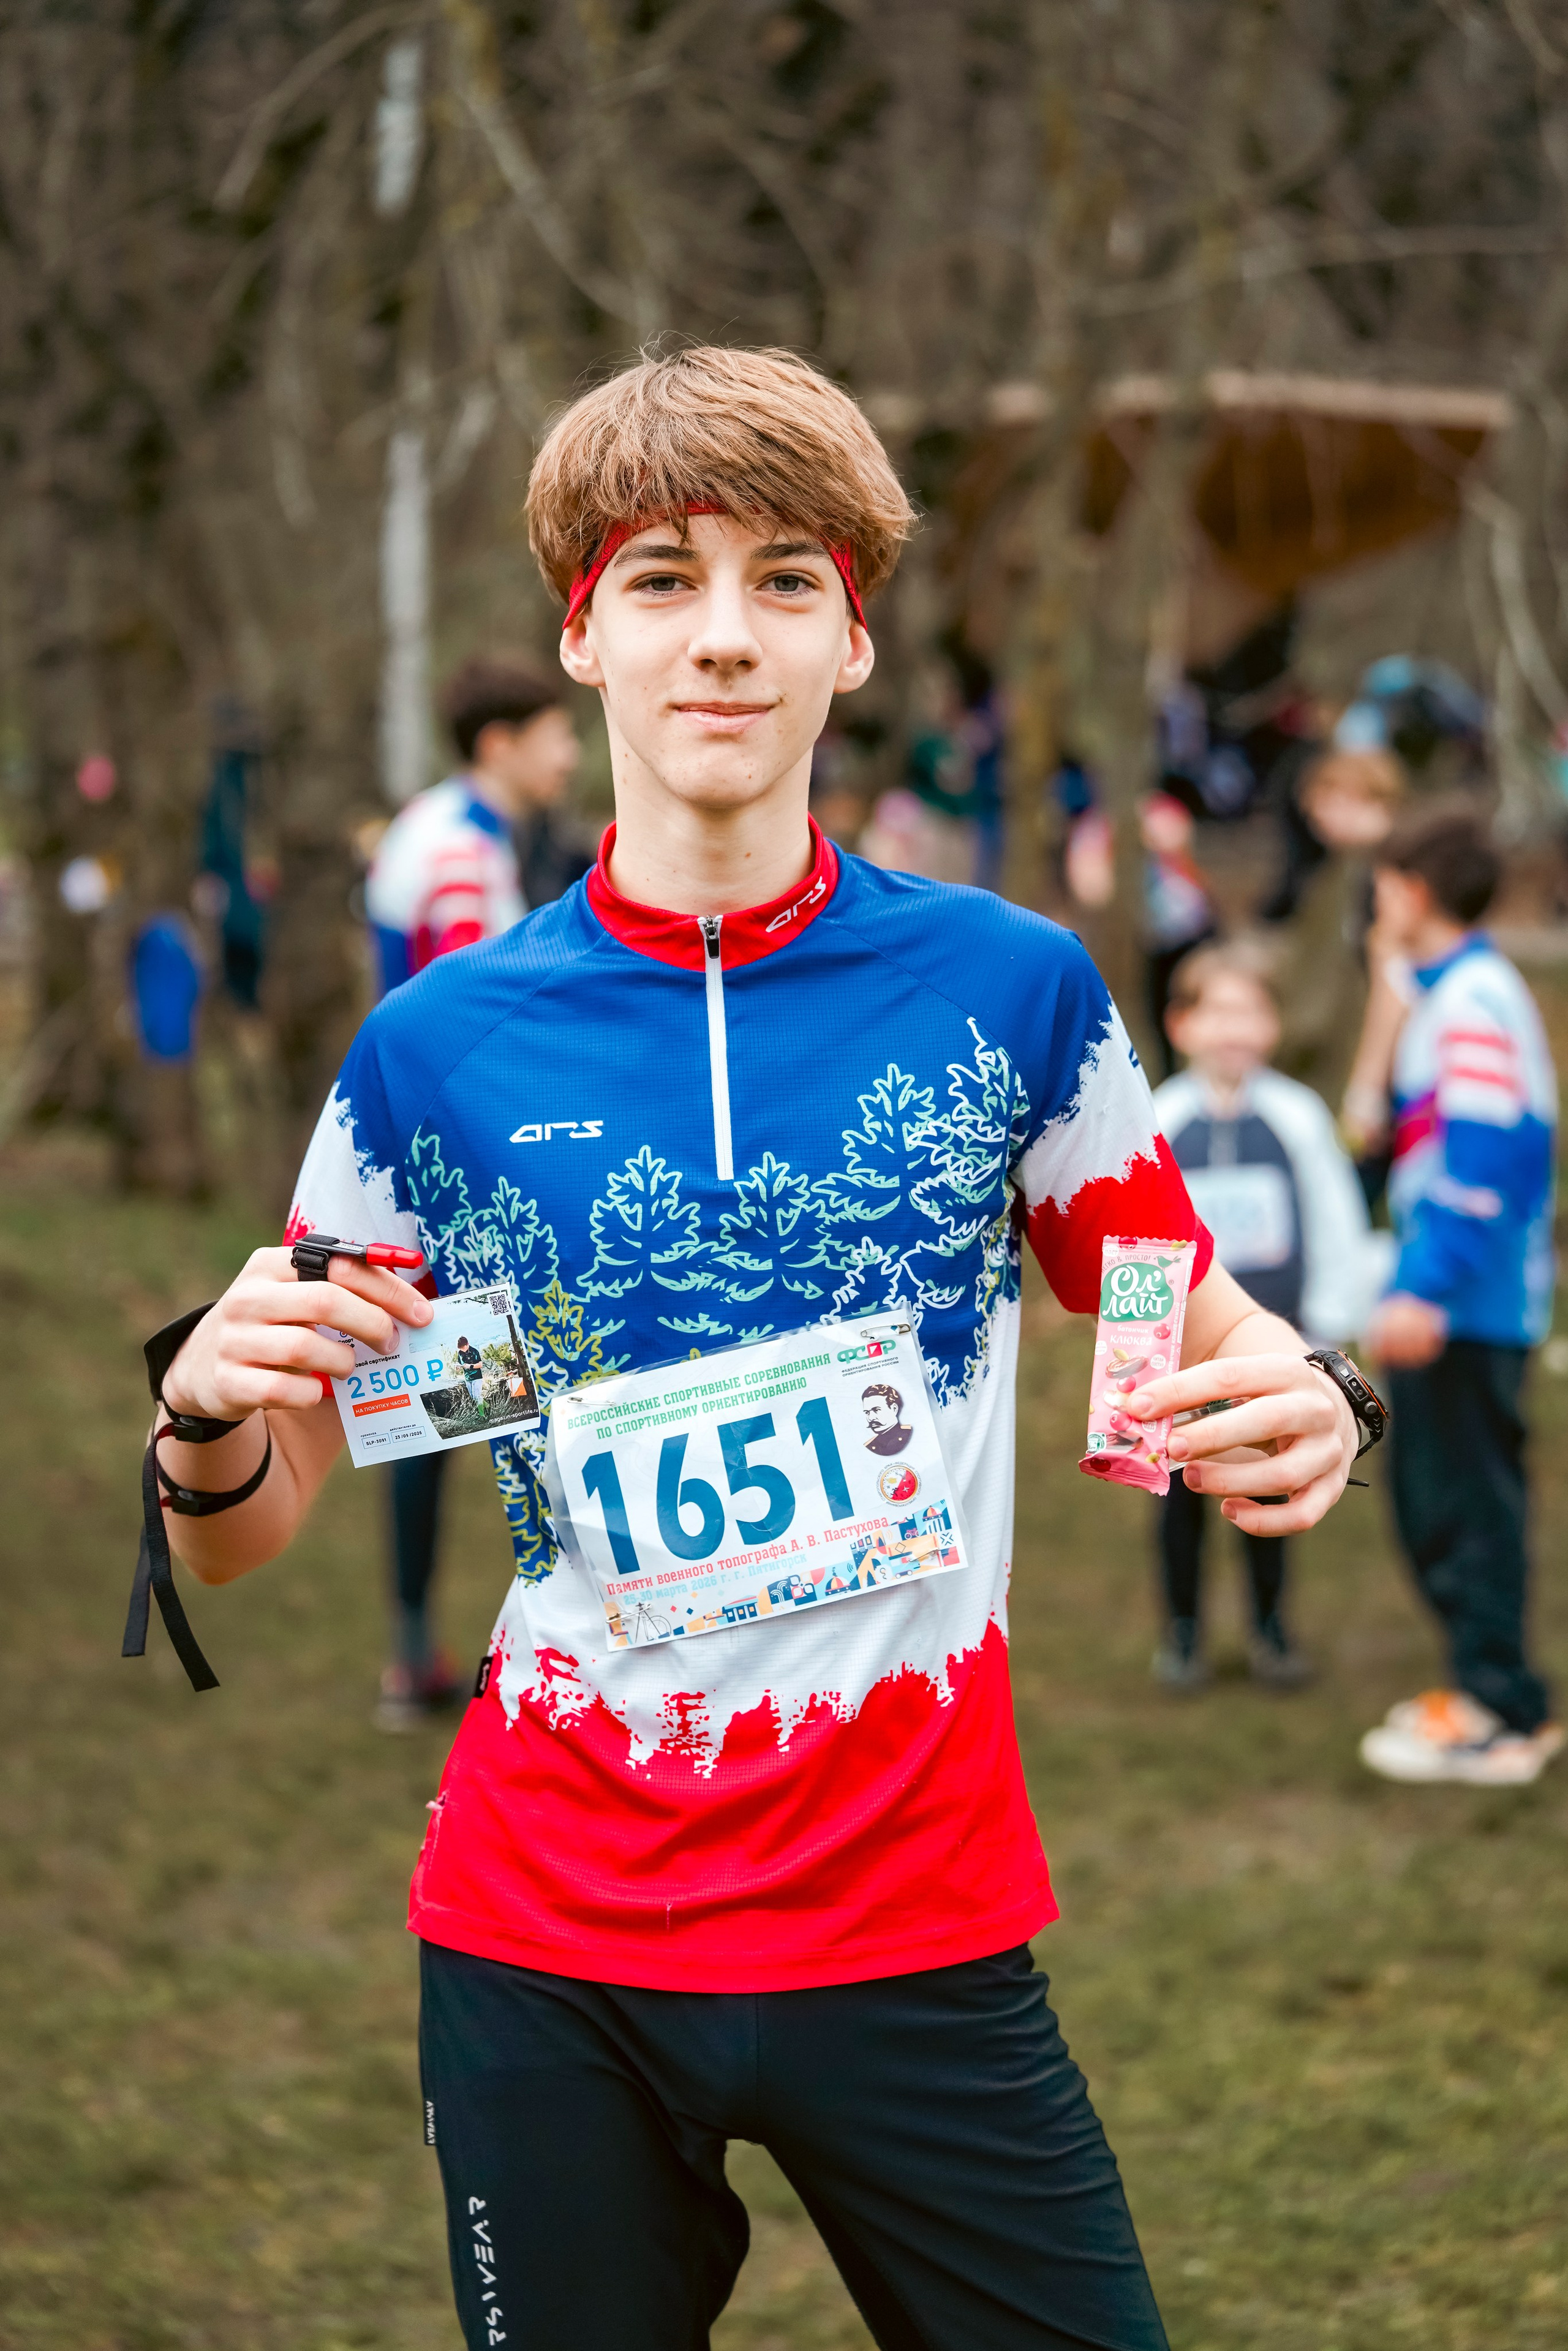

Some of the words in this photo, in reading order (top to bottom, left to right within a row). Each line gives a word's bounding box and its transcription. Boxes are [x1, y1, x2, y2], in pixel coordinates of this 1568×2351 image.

[1117, 1324, 1149, 1334] батончик
[369, 1354, 401, 1365] сертификат
[841, 1364, 867, 1373] ФЕДЕРАЦИЯ
[867, 1356, 899, 1367] СПОРТИВНОГО
[842, 1365, 881, 1377] ОРИЕНТИРОВАНИЯ
[567, 1396, 661, 1430] ВСЕРОССИЙСКИЕ
[663, 1376, 741, 1405] СПОРТИВНЫЕ
[744, 1353, 831, 1386] СОРЕВНОВАНИЯ
[364, 1403, 390, 1412] ПОКУПКУ
[489, 1408, 538, 1424] magazin-sportlife.ru
[596, 1426, 612, 1440] ПО
[615, 1404, 698, 1435] СПОРТИВНОМУ
[701, 1376, 808, 1414] ОРИЕНТИРОВАНИЮ
[581, 1397, 854, 1575] 1651
[606, 1576, 654, 1596] Памяти
[656, 1563, 714, 1585] военного
[717, 1544, 787, 1570] топографа
[790, 1539, 803, 1552] А.
[806, 1534, 821, 1547] В.
[823, 1517, 889, 1542] Пастухова
[623, 1590, 653, 1606] 25-30
[655, 1583, 688, 1599] марта
[690, 1575, 717, 1591] 2026
[747, 1552, 807, 1577] Пятигорск
